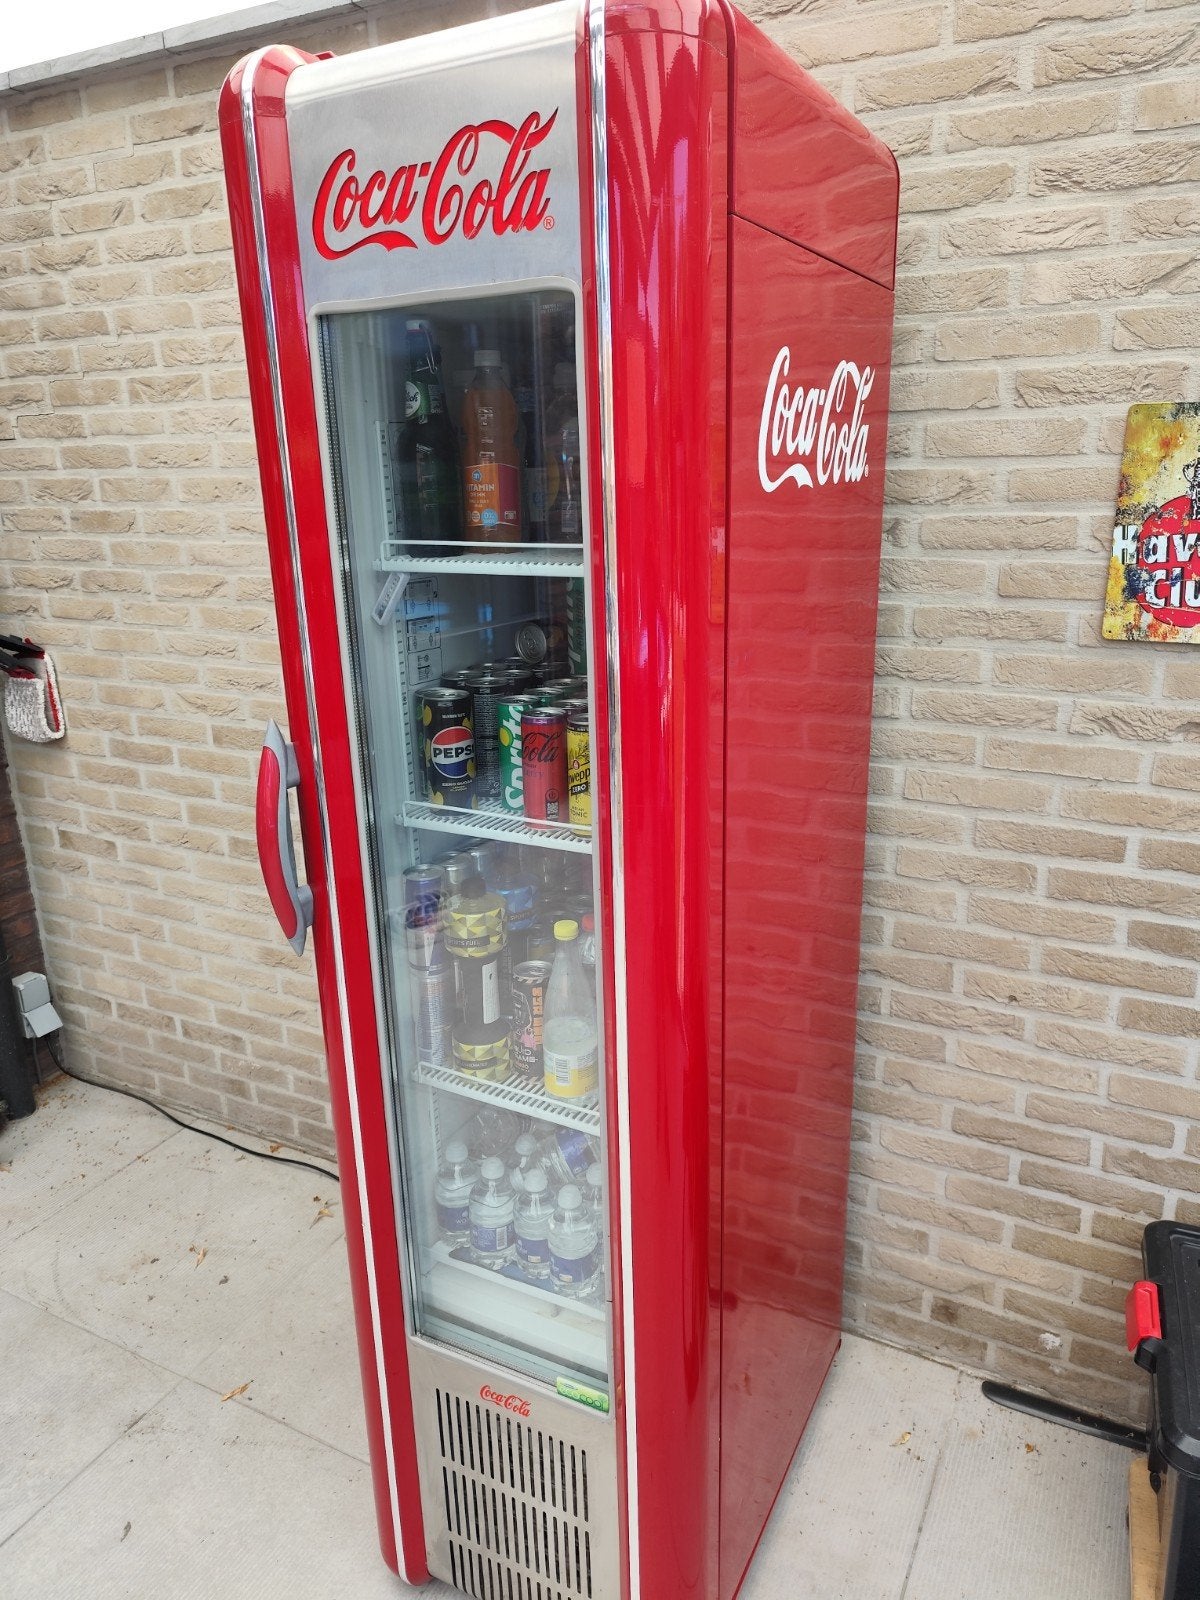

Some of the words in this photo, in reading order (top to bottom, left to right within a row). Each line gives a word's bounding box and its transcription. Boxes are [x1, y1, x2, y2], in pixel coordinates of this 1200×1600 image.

[312, 107, 559, 261] Coca-Cola
[758, 346, 875, 492] Coca-Cola
[467, 483, 495, 491] ITAMIN
[1112, 525, 1200, 565] Hav
[480, 1384, 532, 1417] Coca-Cola
